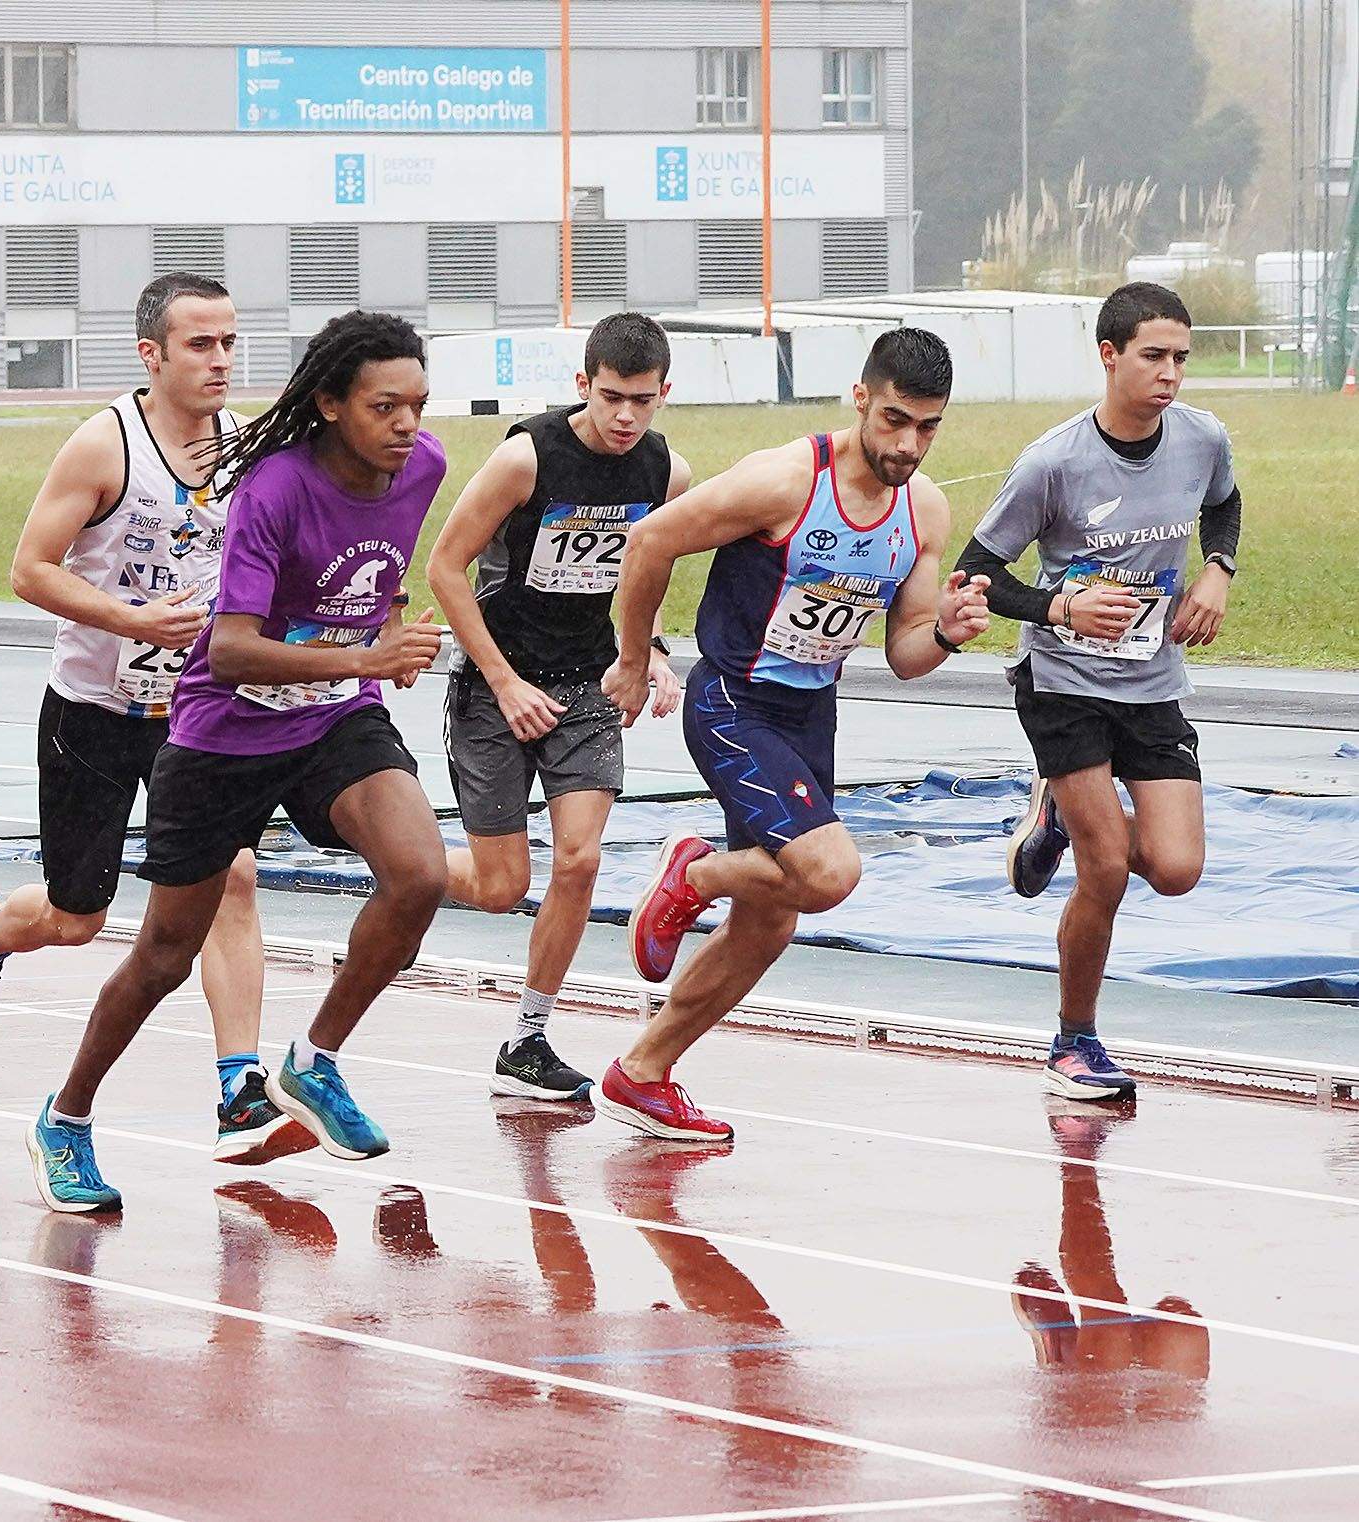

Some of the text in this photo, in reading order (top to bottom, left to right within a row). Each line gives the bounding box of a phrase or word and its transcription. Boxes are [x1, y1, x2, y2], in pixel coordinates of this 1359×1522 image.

[359, 64, 533, 91] Centro Galego de
[295, 98, 533, 124] Tecnificación Deportiva
[383, 158, 436, 170] DEPORTE
[383, 173, 432, 185] GALEGO
[696, 176, 815, 197] DE GAICIA
[24, 181, 116, 202] GALICIA
[573, 505, 626, 520] XI MILLA
[604, 521, 630, 531] DIABET
[1085, 520, 1196, 550] NEW ZEALAND
[550, 531, 627, 565] 192
[316, 540, 406, 587] COIDA O TEU PLANETA
[1099, 564, 1155, 585] XI MILLA
[829, 572, 881, 595] XI MILLA
[789, 594, 876, 640] 301
